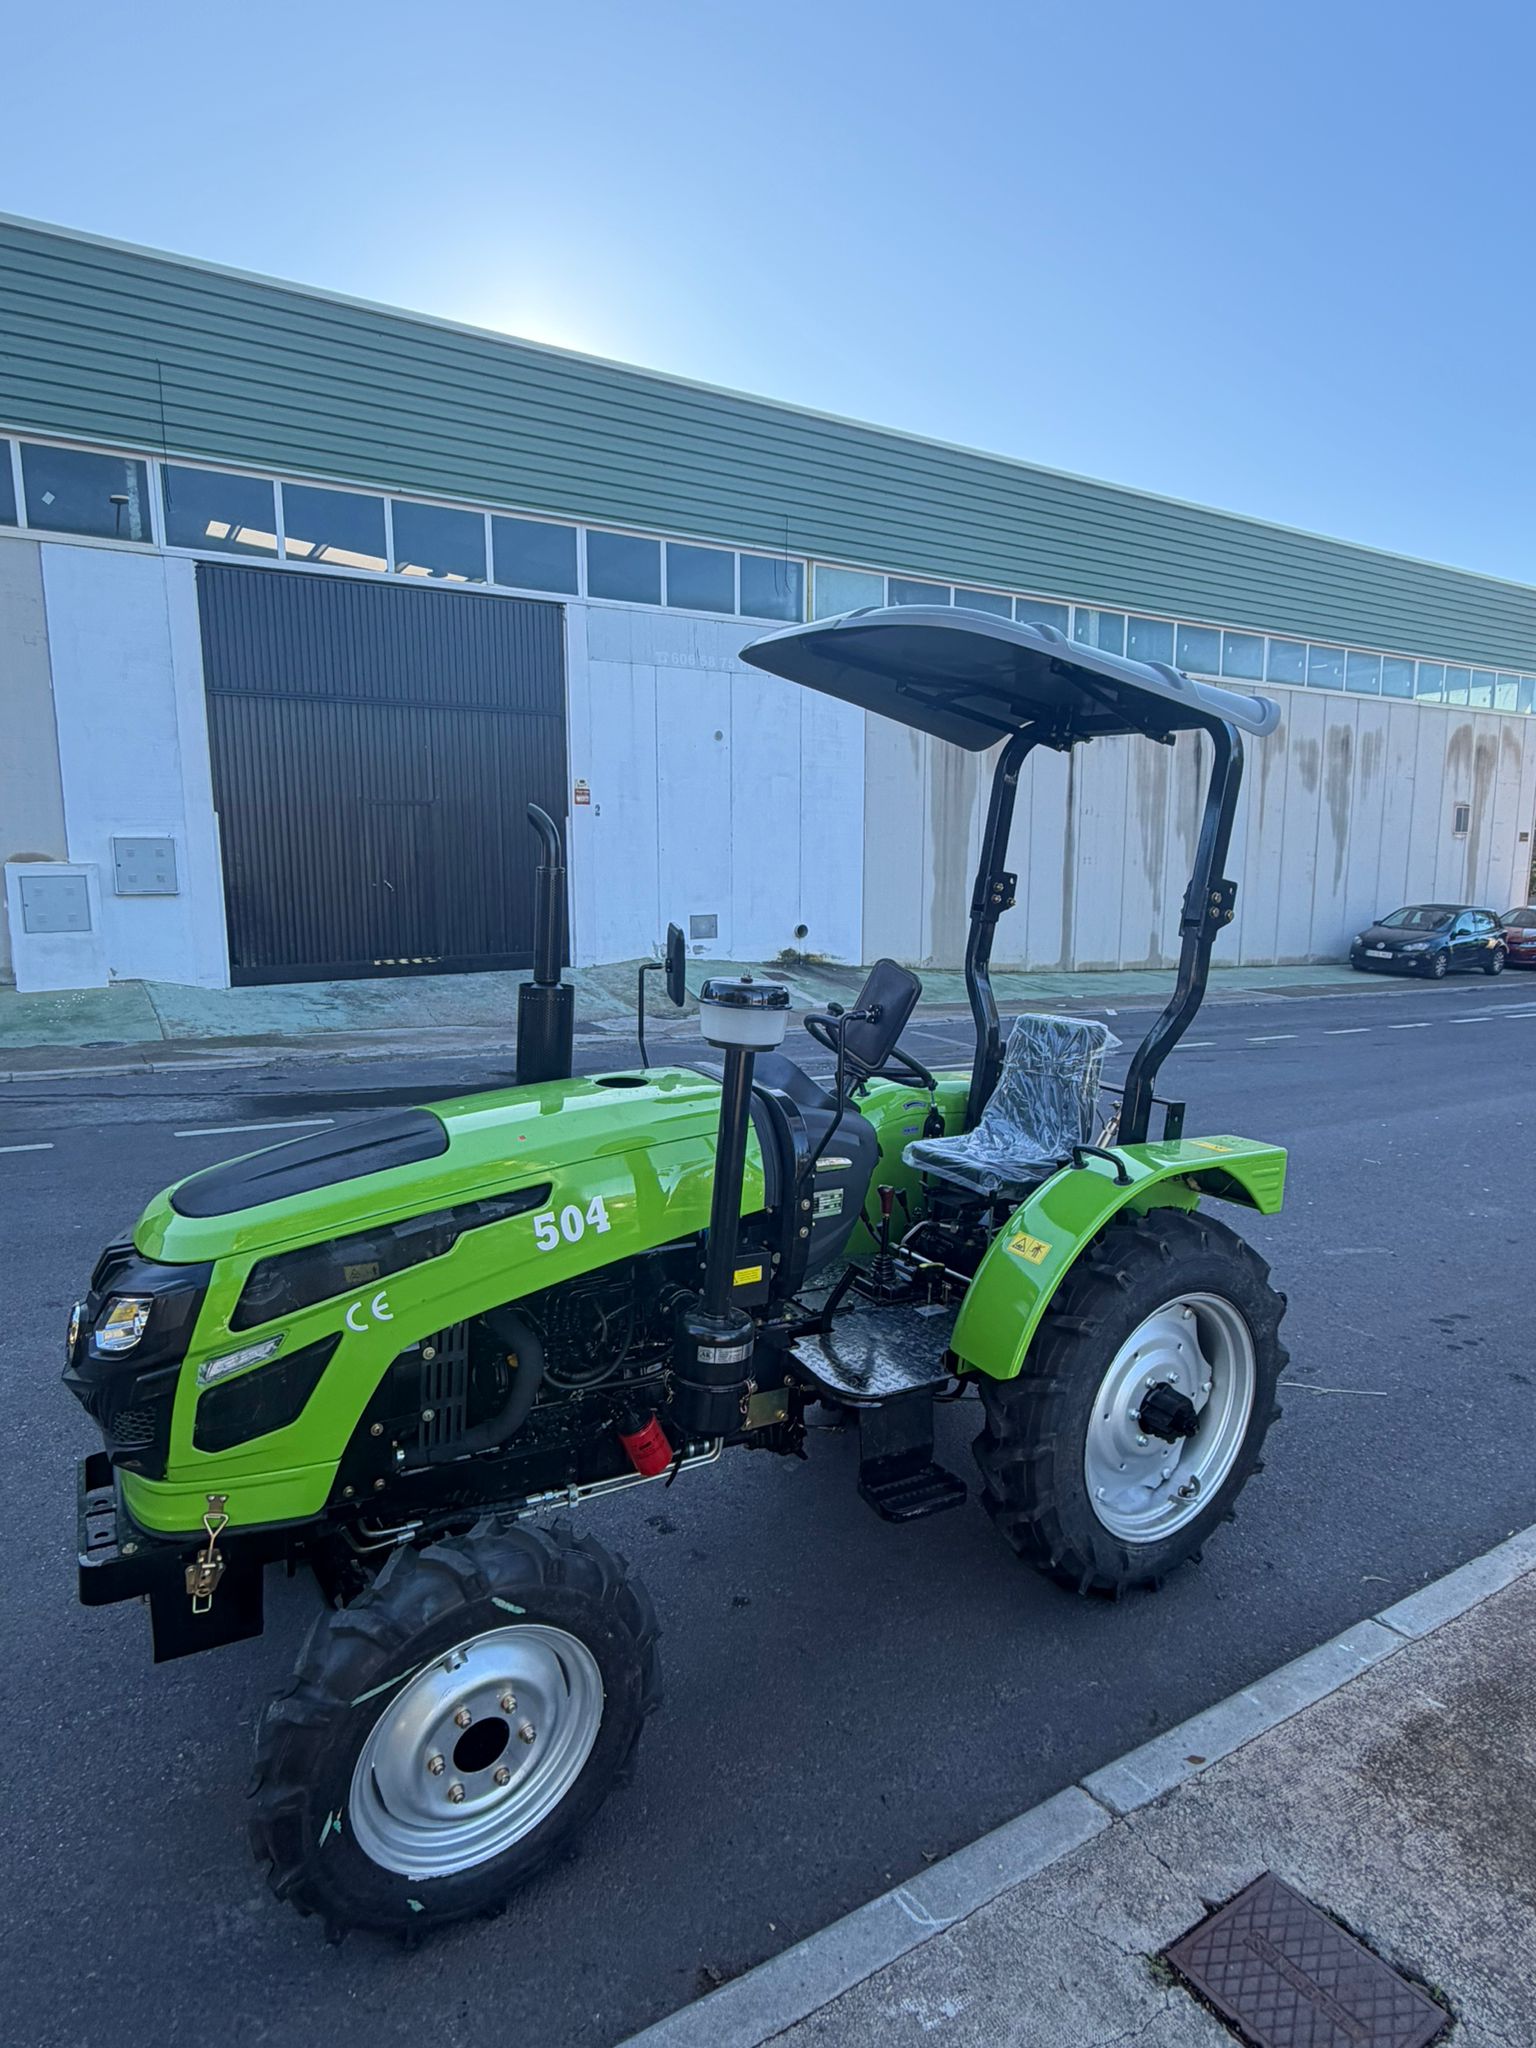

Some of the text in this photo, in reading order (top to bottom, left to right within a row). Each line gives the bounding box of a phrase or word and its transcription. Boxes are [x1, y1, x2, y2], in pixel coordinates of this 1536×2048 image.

[719, 657, 736, 670] 75
[533, 1195, 611, 1252] 504
[345, 1290, 394, 1332] CE
